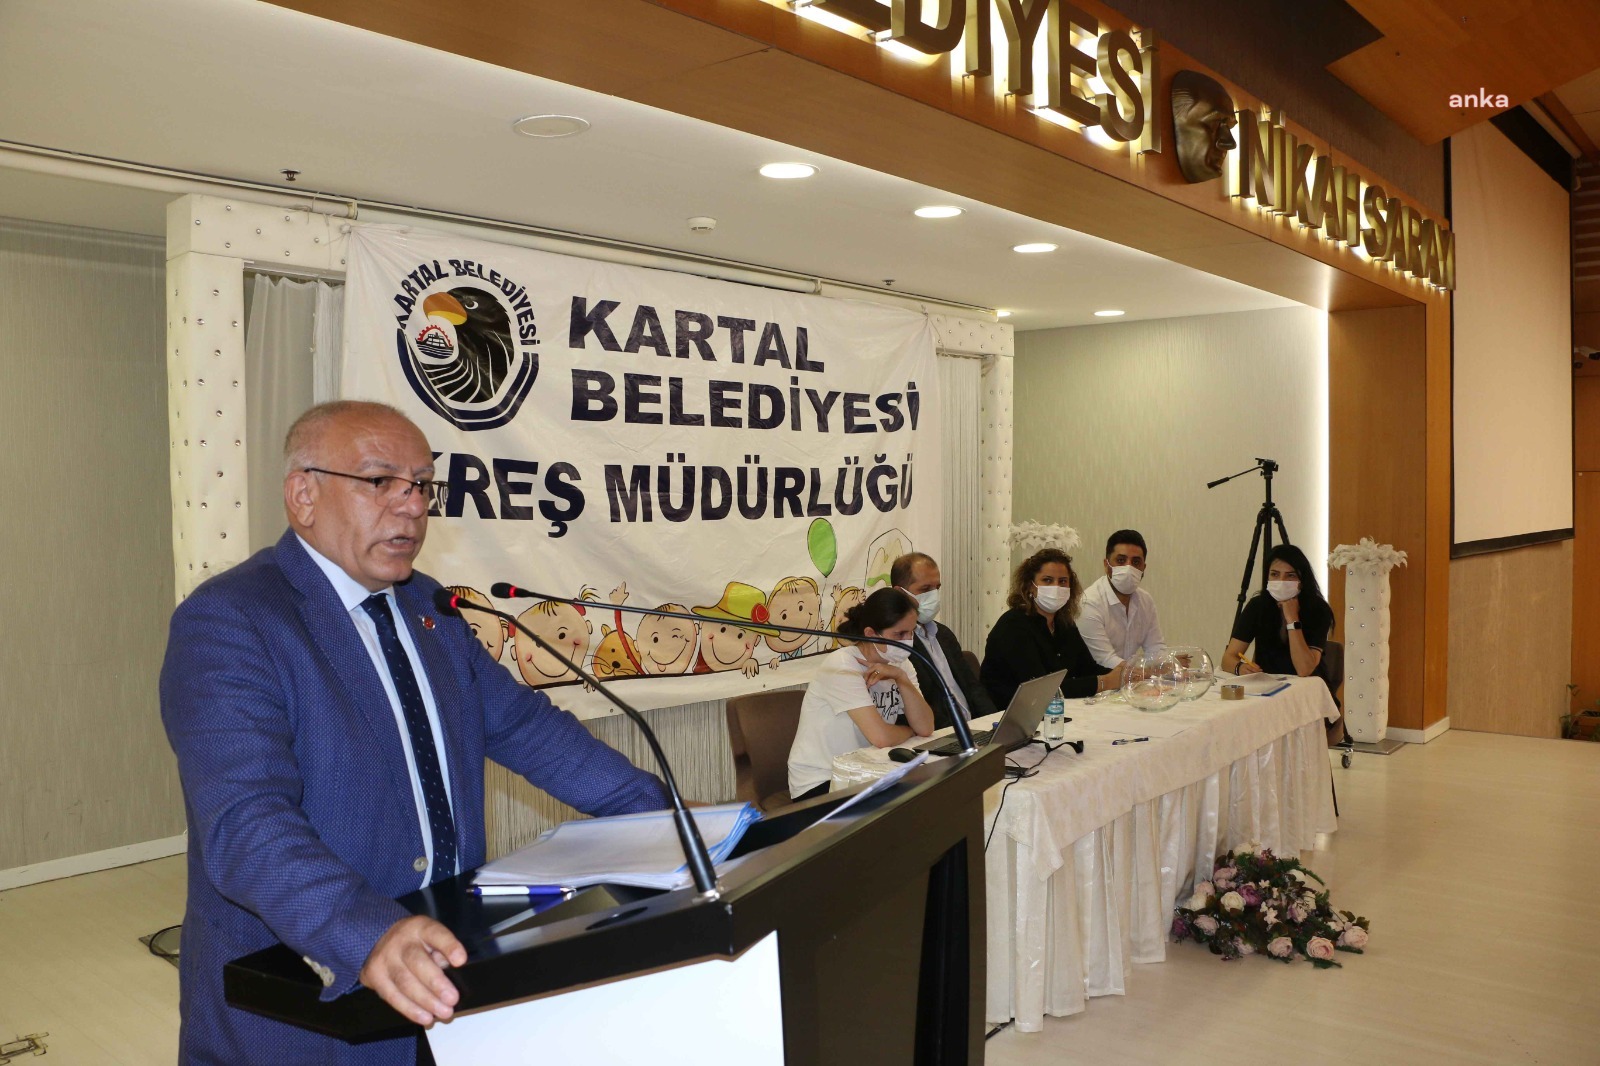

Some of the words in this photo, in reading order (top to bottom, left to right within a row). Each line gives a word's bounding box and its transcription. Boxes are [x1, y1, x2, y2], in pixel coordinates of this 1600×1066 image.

[1237, 109, 1361, 247] NİKAH
[394, 260, 450, 330] KARTAL
[448, 259, 541, 346] BELEDİYESİ
[568, 295, 825, 373] KARTAL
[570, 368, 920, 434] BELEDİYESİ
[604, 452, 913, 523] MÜDÜRLÜĞÜ
